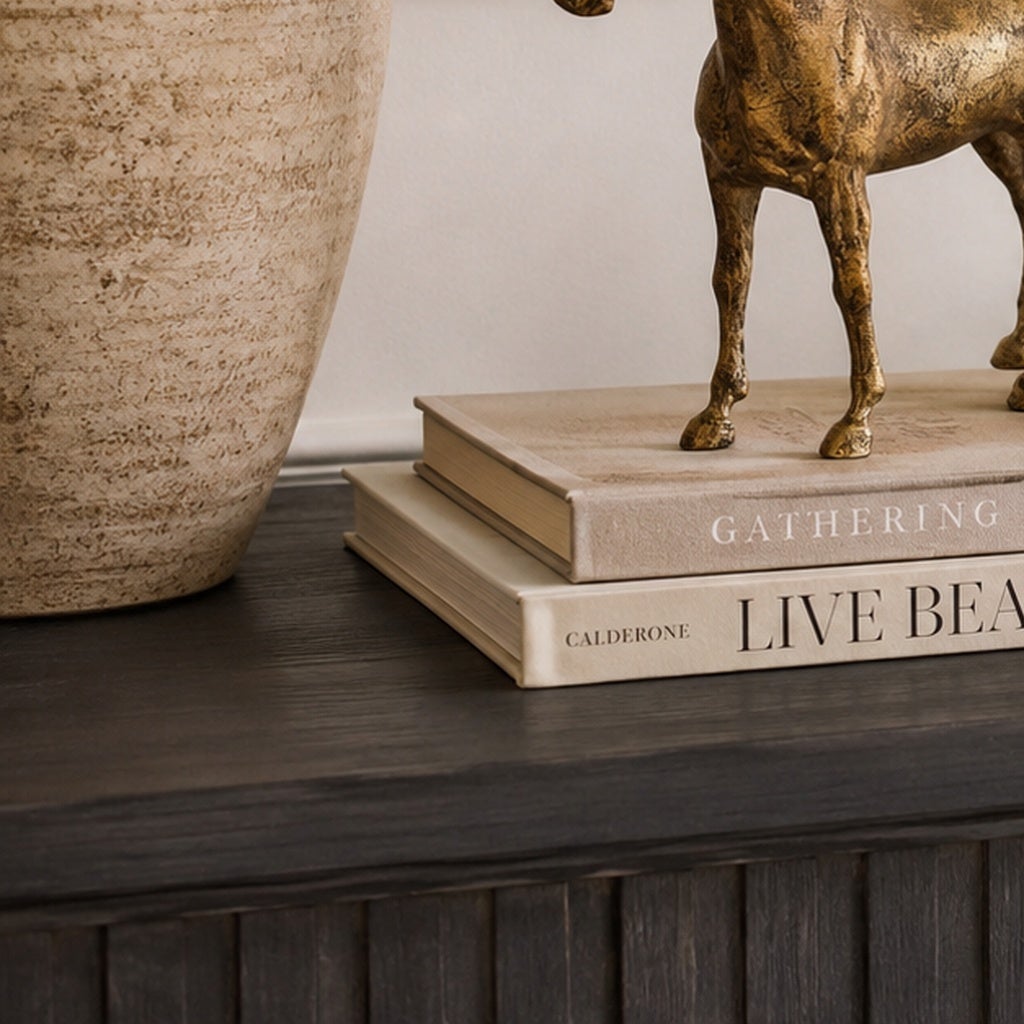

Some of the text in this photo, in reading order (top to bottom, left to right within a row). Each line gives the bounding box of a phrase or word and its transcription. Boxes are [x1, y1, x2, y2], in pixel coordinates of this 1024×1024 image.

[711, 499, 999, 544] GATHERING
[565, 623, 690, 648] CALDERONE
[737, 589, 883, 653] LIVE
